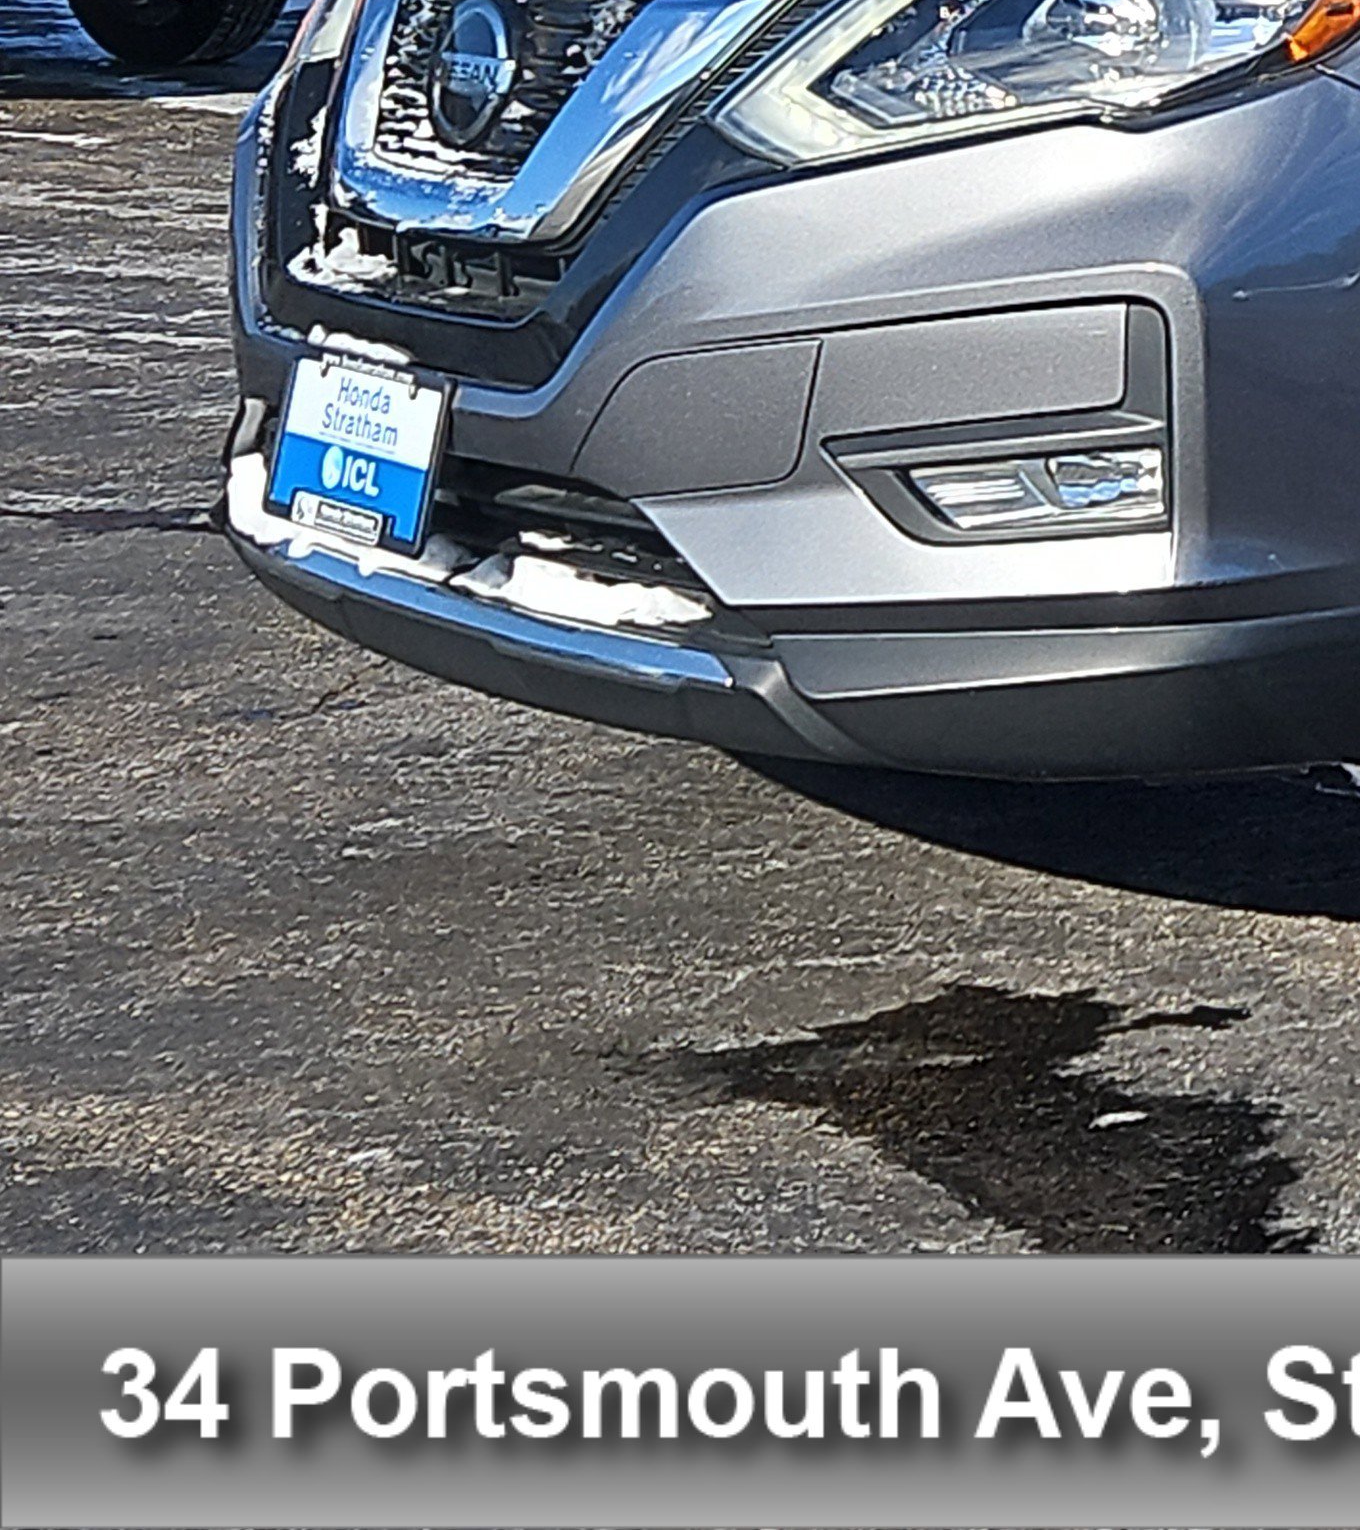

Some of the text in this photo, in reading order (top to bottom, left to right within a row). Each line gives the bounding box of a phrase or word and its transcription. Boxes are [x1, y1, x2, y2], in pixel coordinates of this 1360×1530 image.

[337, 376, 391, 415] Honda
[321, 402, 398, 447] Stratham
[341, 455, 380, 497] ICL
